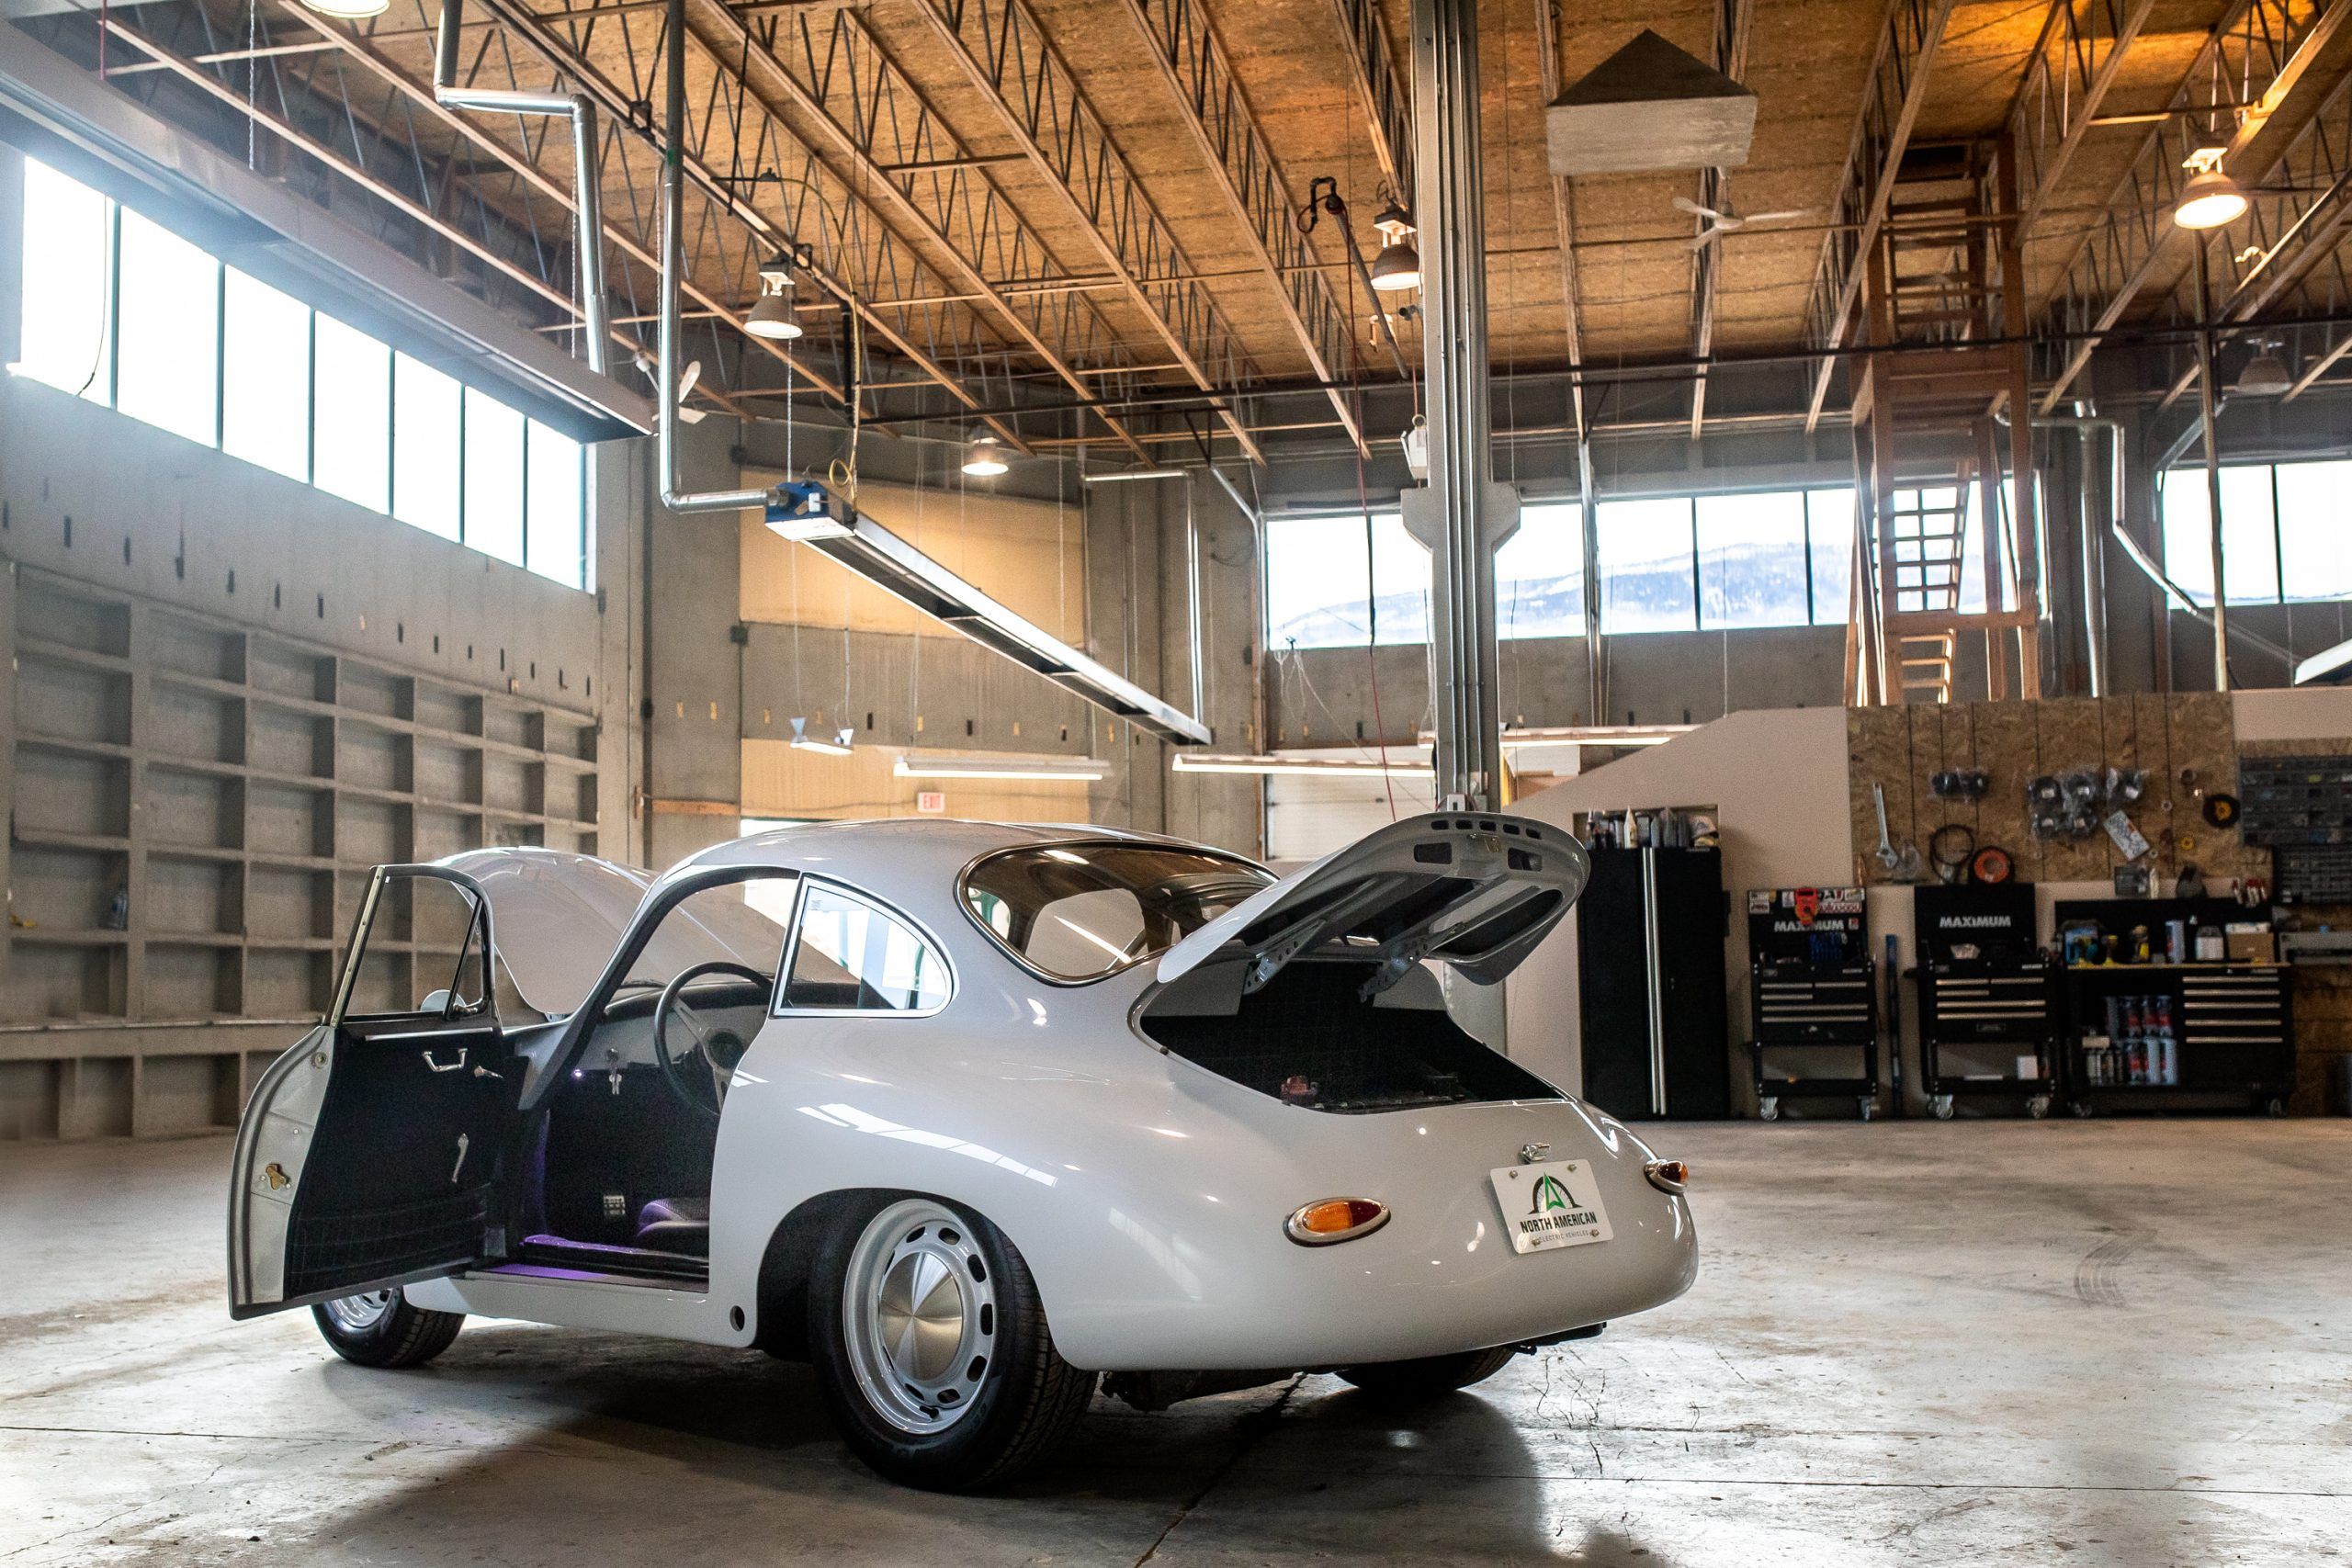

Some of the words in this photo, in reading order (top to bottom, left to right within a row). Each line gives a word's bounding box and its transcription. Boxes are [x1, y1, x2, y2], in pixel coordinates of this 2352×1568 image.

[1773, 919, 1845, 932] MAXMUM
[1520, 1217, 1553, 1234] NORTH
[1553, 1211, 1598, 1228] AMERICAN
[1565, 1229, 1589, 1239] VEHICLES
